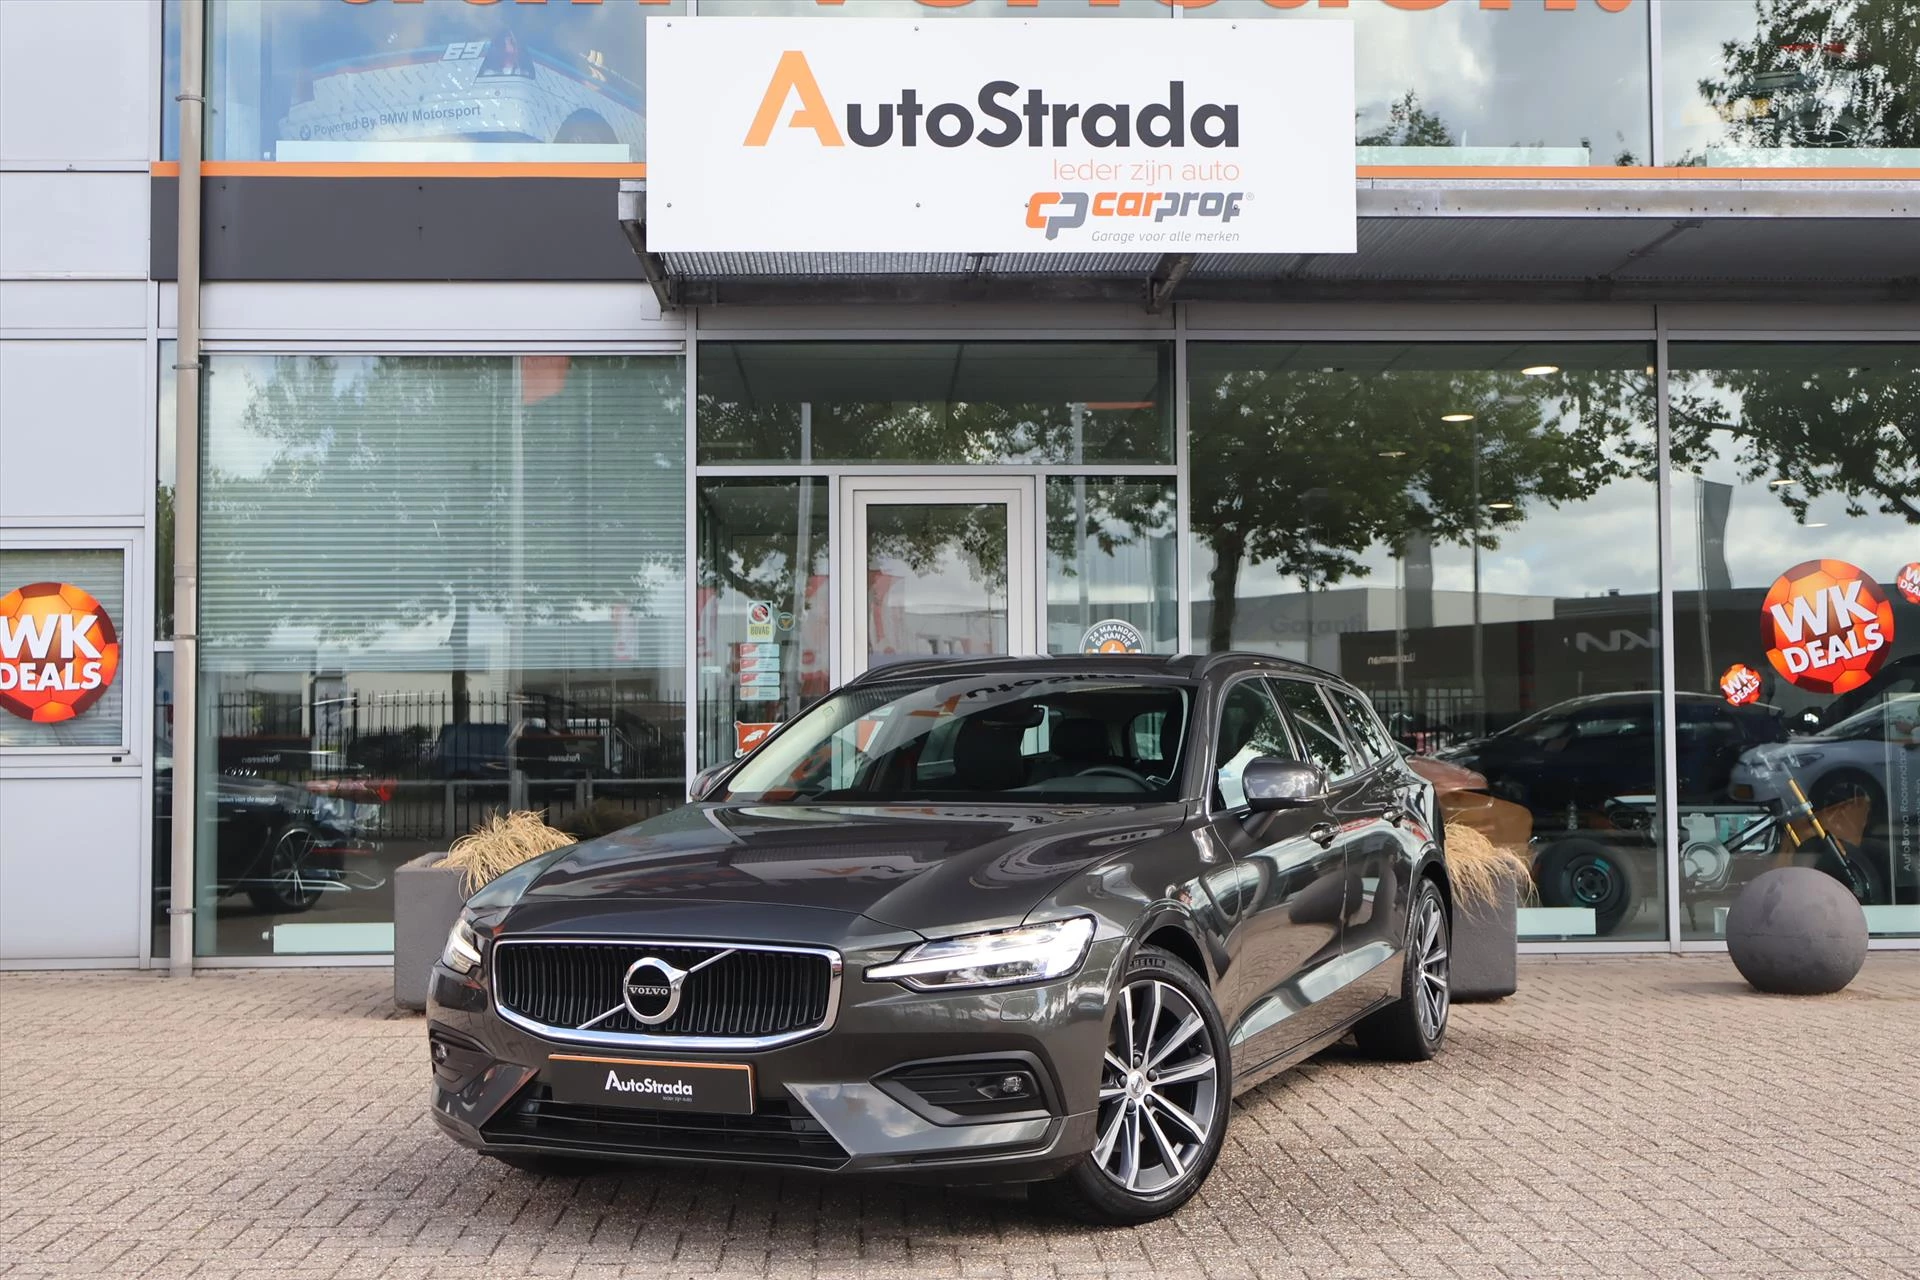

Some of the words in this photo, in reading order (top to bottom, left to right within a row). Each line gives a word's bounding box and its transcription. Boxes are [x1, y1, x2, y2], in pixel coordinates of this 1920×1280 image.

[442, 41, 485, 60] 69
[742, 50, 1240, 149] AutoStrada
[314, 117, 359, 136] Powered
[361, 115, 376, 131] By
[379, 111, 409, 126] BMW
[412, 104, 482, 122] Motorsport
[1130, 159, 1172, 186] zijn
[1182, 160, 1240, 181] auto
[1091, 230, 1135, 244] Garage
[1138, 231, 1166, 242] voor
[1169, 230, 1191, 242] alle
[1194, 230, 1240, 242] merken
[1769, 579, 1878, 643] WK
[0, 613, 103, 659] WK
[1089, 631, 1100, 643] 24
[1099, 624, 1138, 643] MAANDEN
[1095, 632, 1132, 648] GARANTIE
[1782, 623, 1885, 674] DEALS
[0, 661, 102, 691] DEALS
[1722, 667, 1754, 695] WK
[1731, 678, 1760, 703] DEALS
[630, 986, 669, 996] VOLVO
[604, 1070, 693, 1096] AutoStrada
